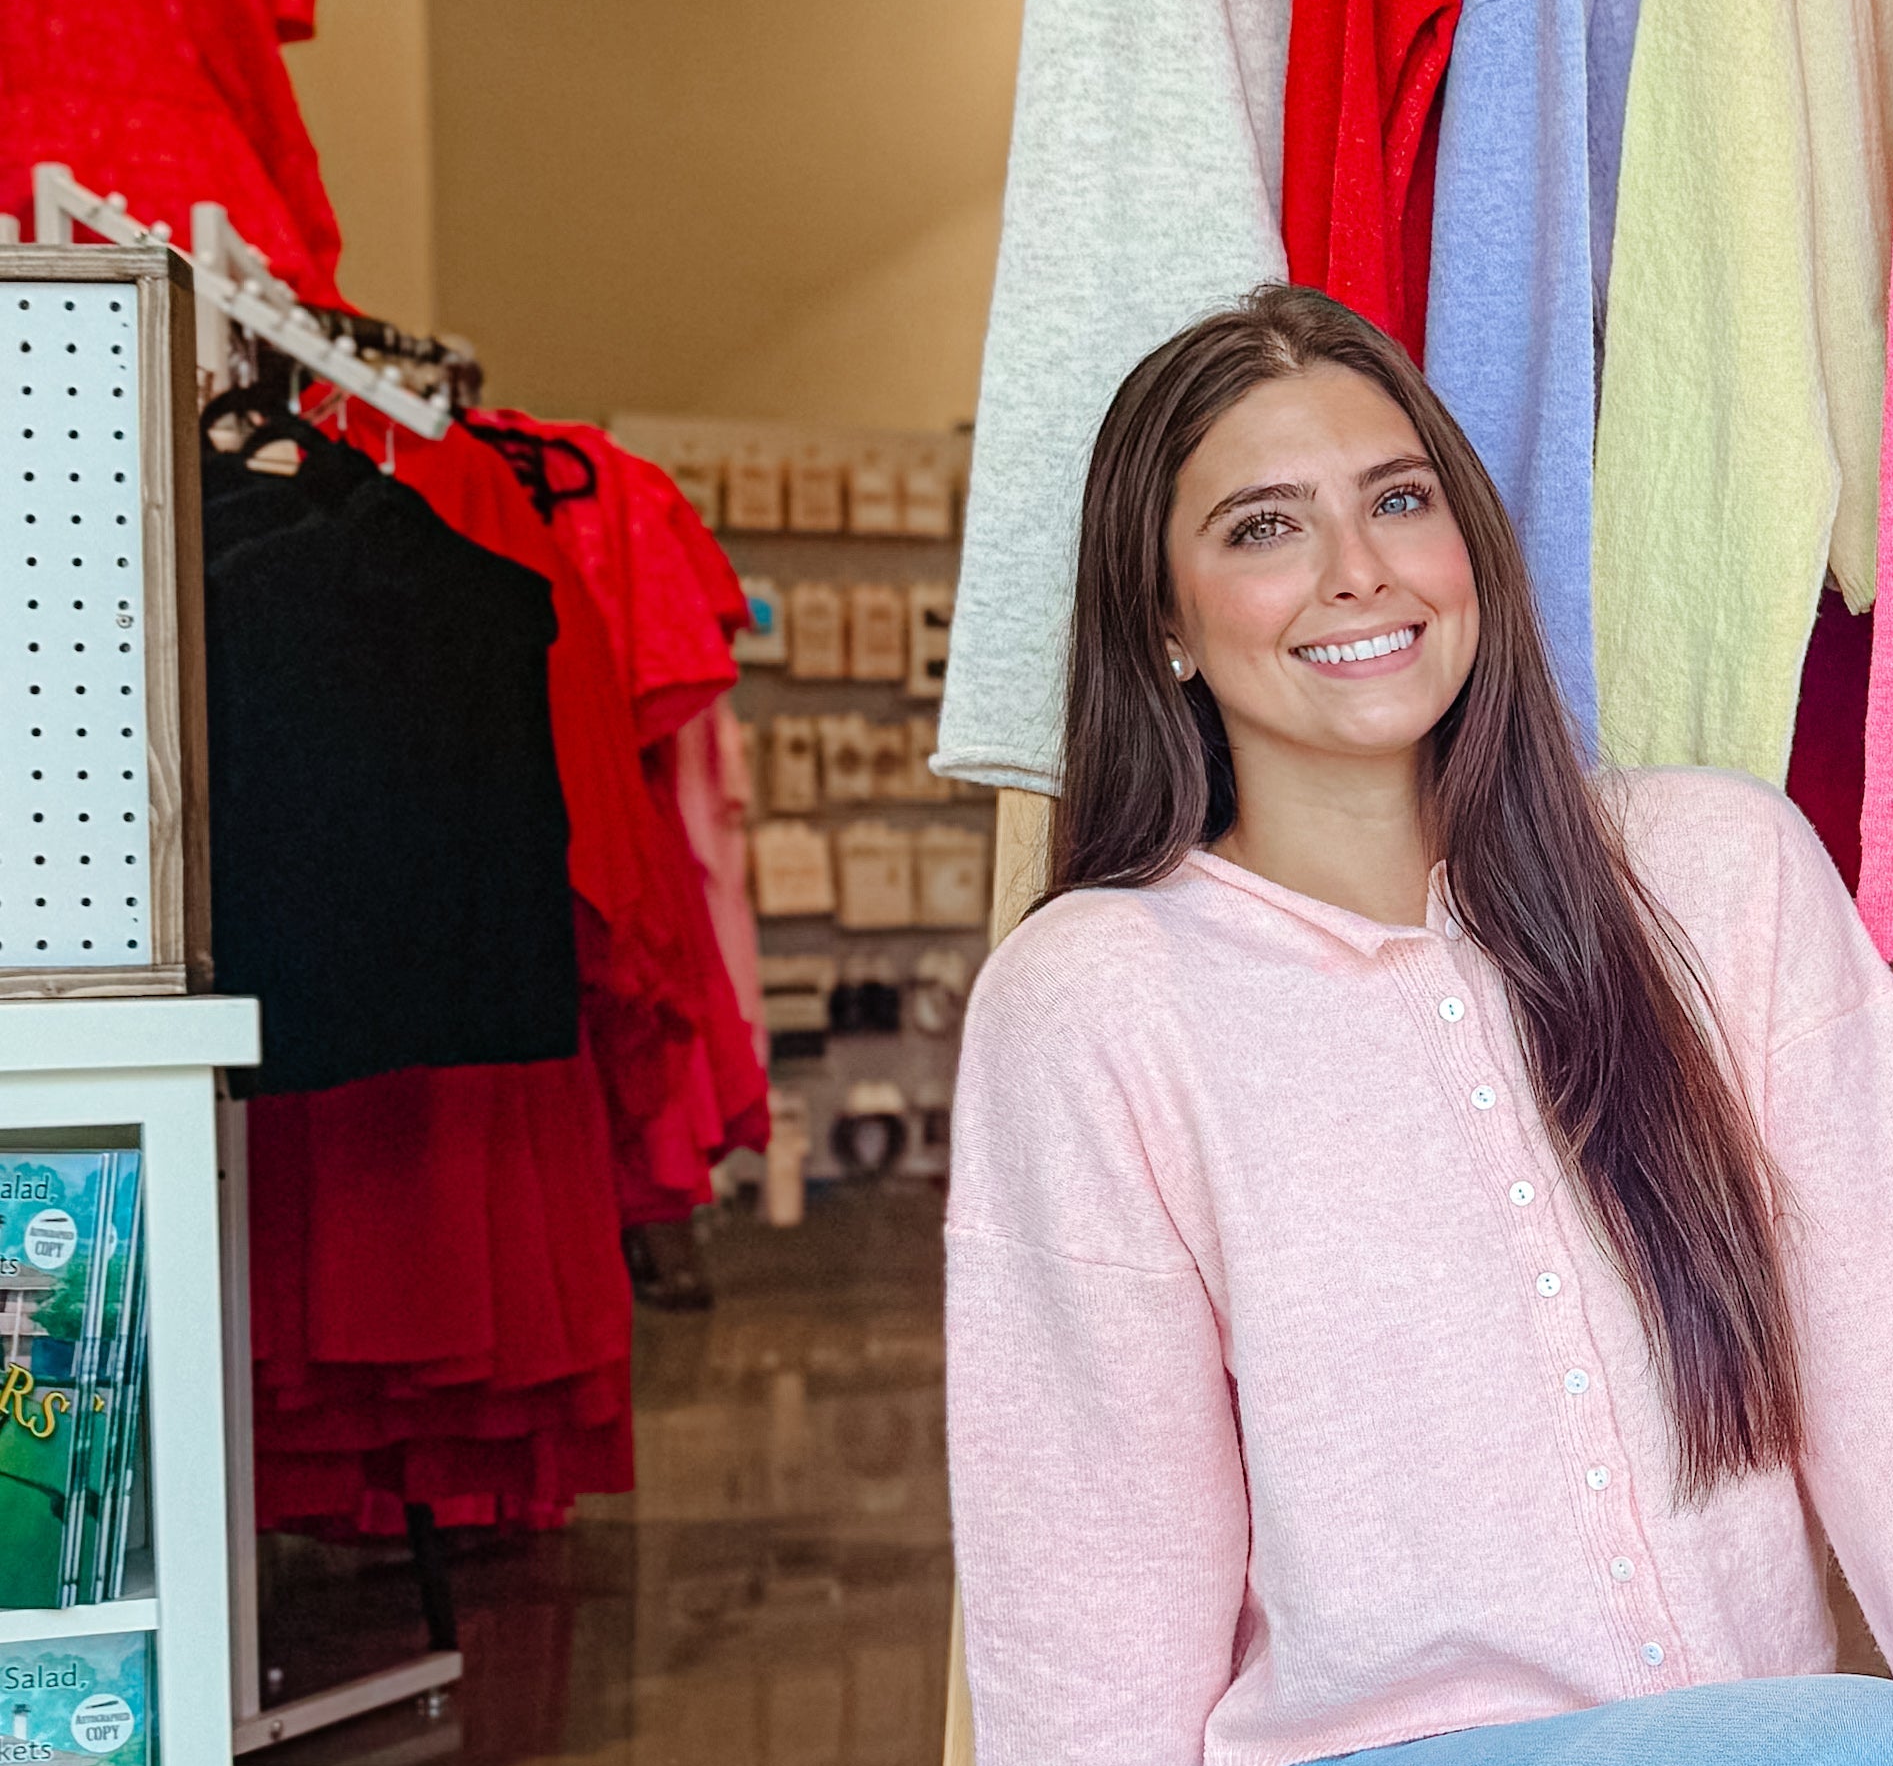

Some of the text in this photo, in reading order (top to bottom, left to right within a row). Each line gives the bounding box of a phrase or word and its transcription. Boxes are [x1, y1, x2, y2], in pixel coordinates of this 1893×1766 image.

[35, 1240, 64, 1258] COPY
[4, 1663, 88, 1690] Salad,
[86, 1725, 120, 1742] COPY
